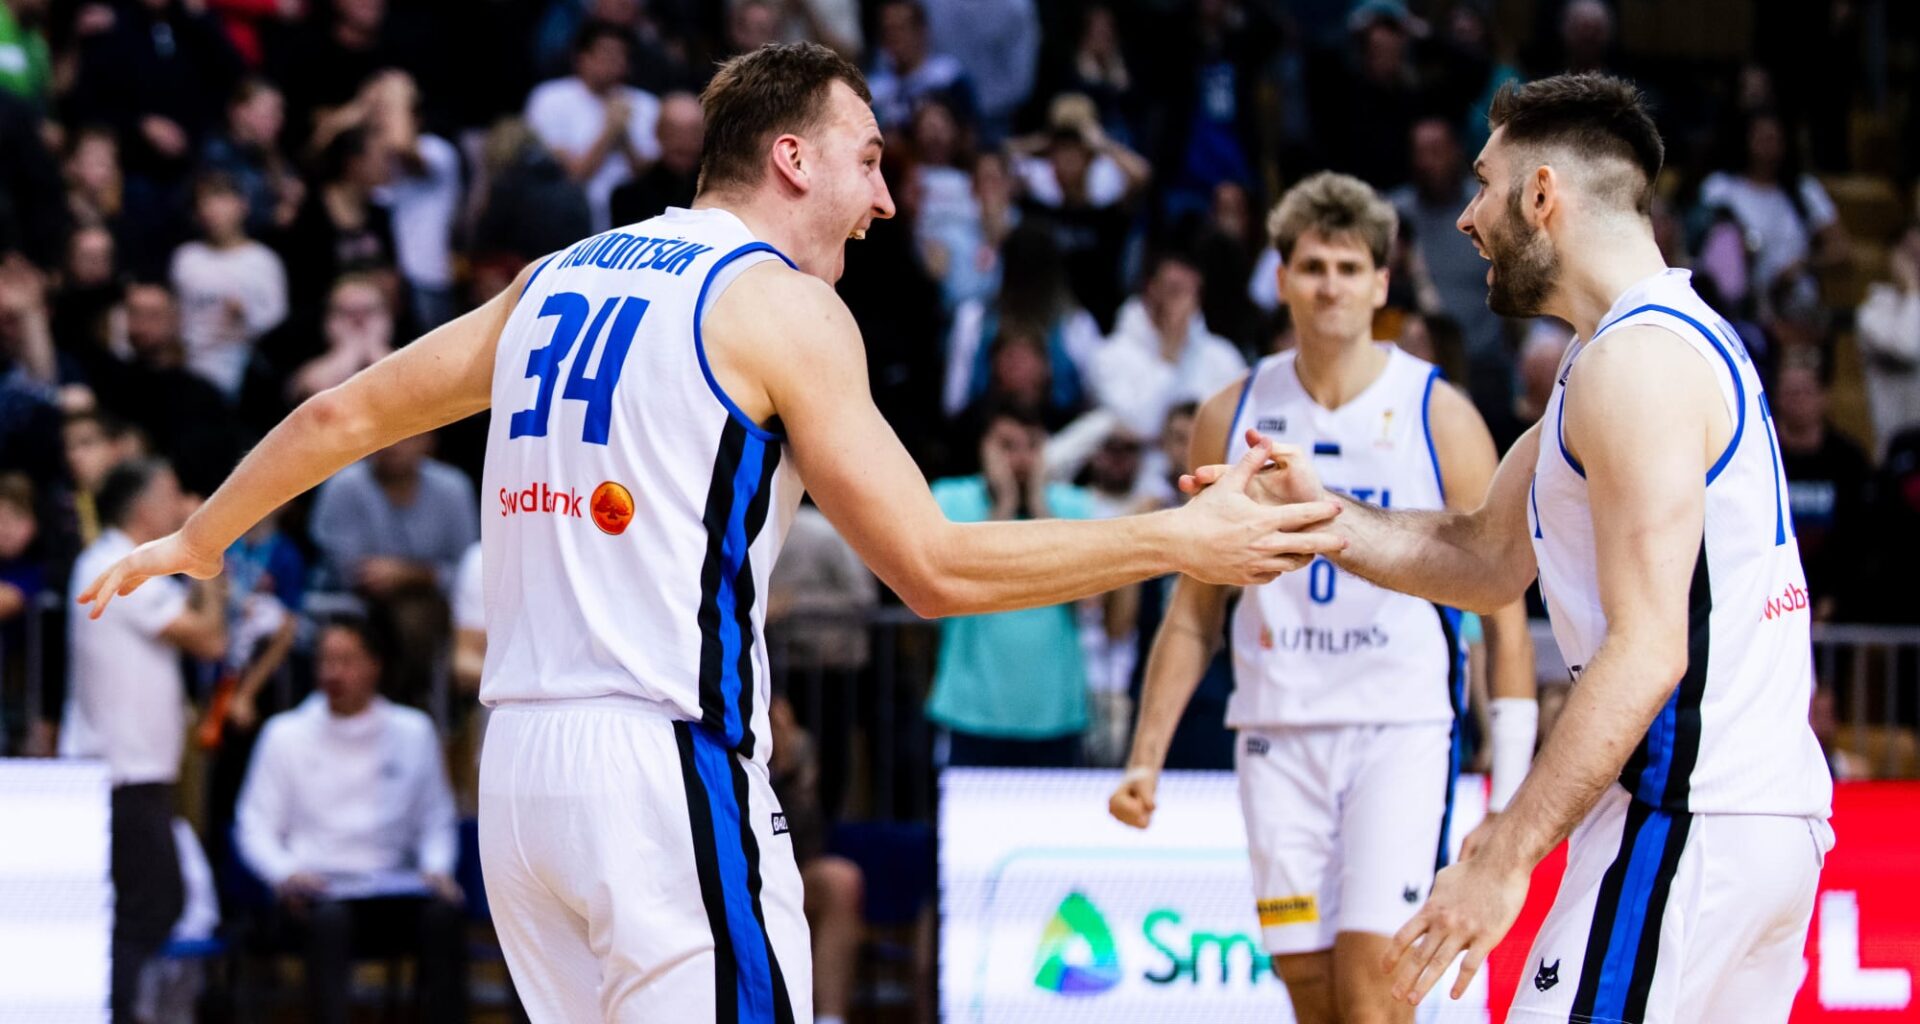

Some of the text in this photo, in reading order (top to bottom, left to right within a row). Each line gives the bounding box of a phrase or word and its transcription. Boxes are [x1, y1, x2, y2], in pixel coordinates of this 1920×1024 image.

[509, 291, 651, 446] 34
[1757, 390, 1797, 547] 1
[1309, 558, 1336, 605] 0
[1142, 908, 1281, 985] Sm
[1803, 889, 1913, 1010] L
